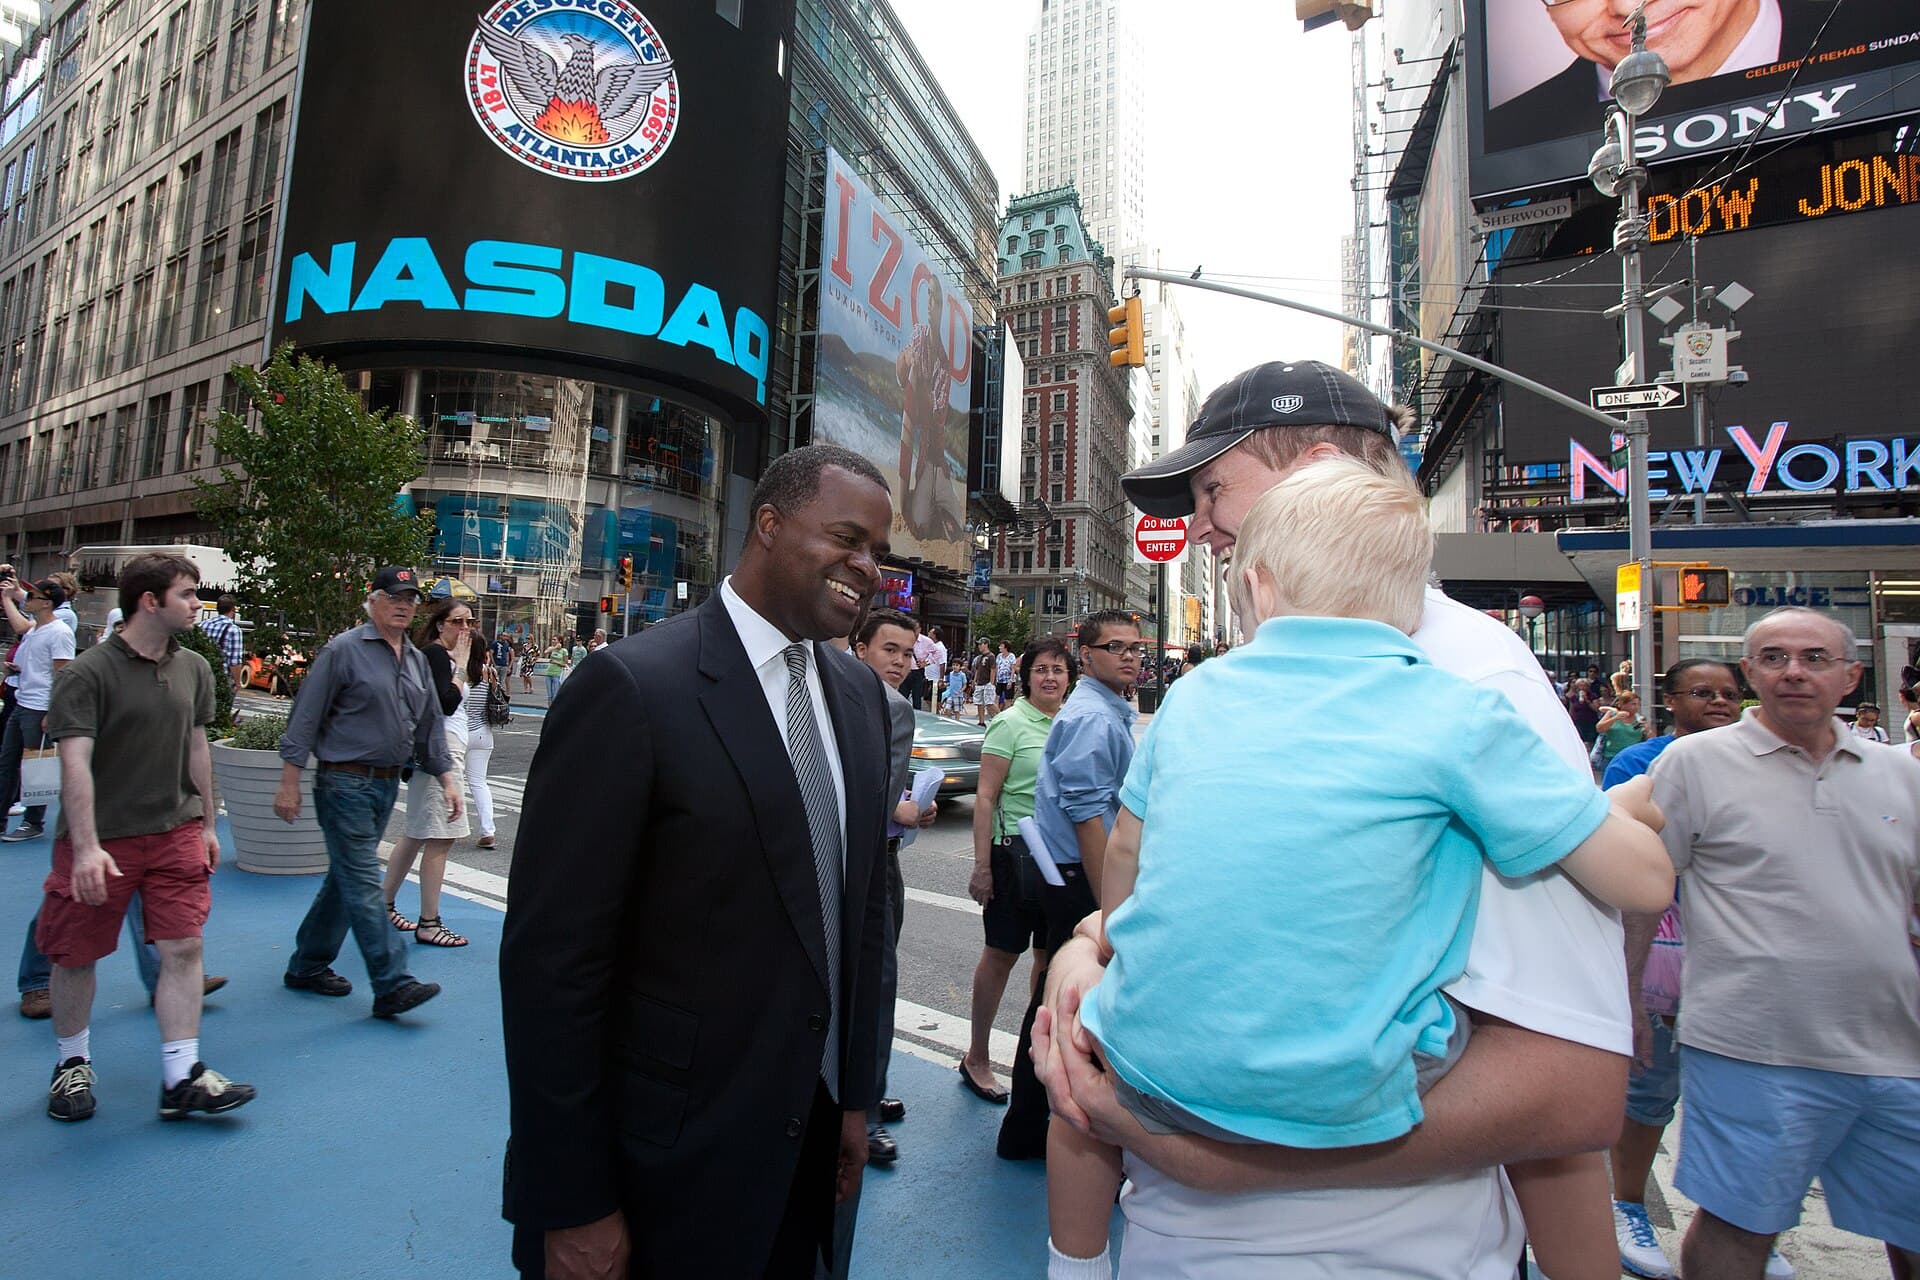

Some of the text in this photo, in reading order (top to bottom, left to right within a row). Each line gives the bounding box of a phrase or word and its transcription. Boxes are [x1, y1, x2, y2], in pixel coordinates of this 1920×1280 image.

[497, 0, 657, 61] RESURGENS
[1745, 31, 1920, 79] CELEBRIY REHAB SUNDA
[642, 95, 667, 144] 1865
[1635, 83, 1856, 158] SONY
[1482, 204, 1568, 229] SHERWOOD
[1648, 178, 1759, 242] DOW
[284, 237, 769, 405] NASDAQ
[829, 281, 868, 322] LUXURY
[1605, 390, 1671, 405] ONE WAY
[1570, 421, 1920, 500] NEW YORK
[1144, 518, 1178, 529] DO NOT
[1146, 542, 1176, 552] ENTER
[1733, 586, 1830, 606] OLICE
[23, 790, 59, 798] DIESE
